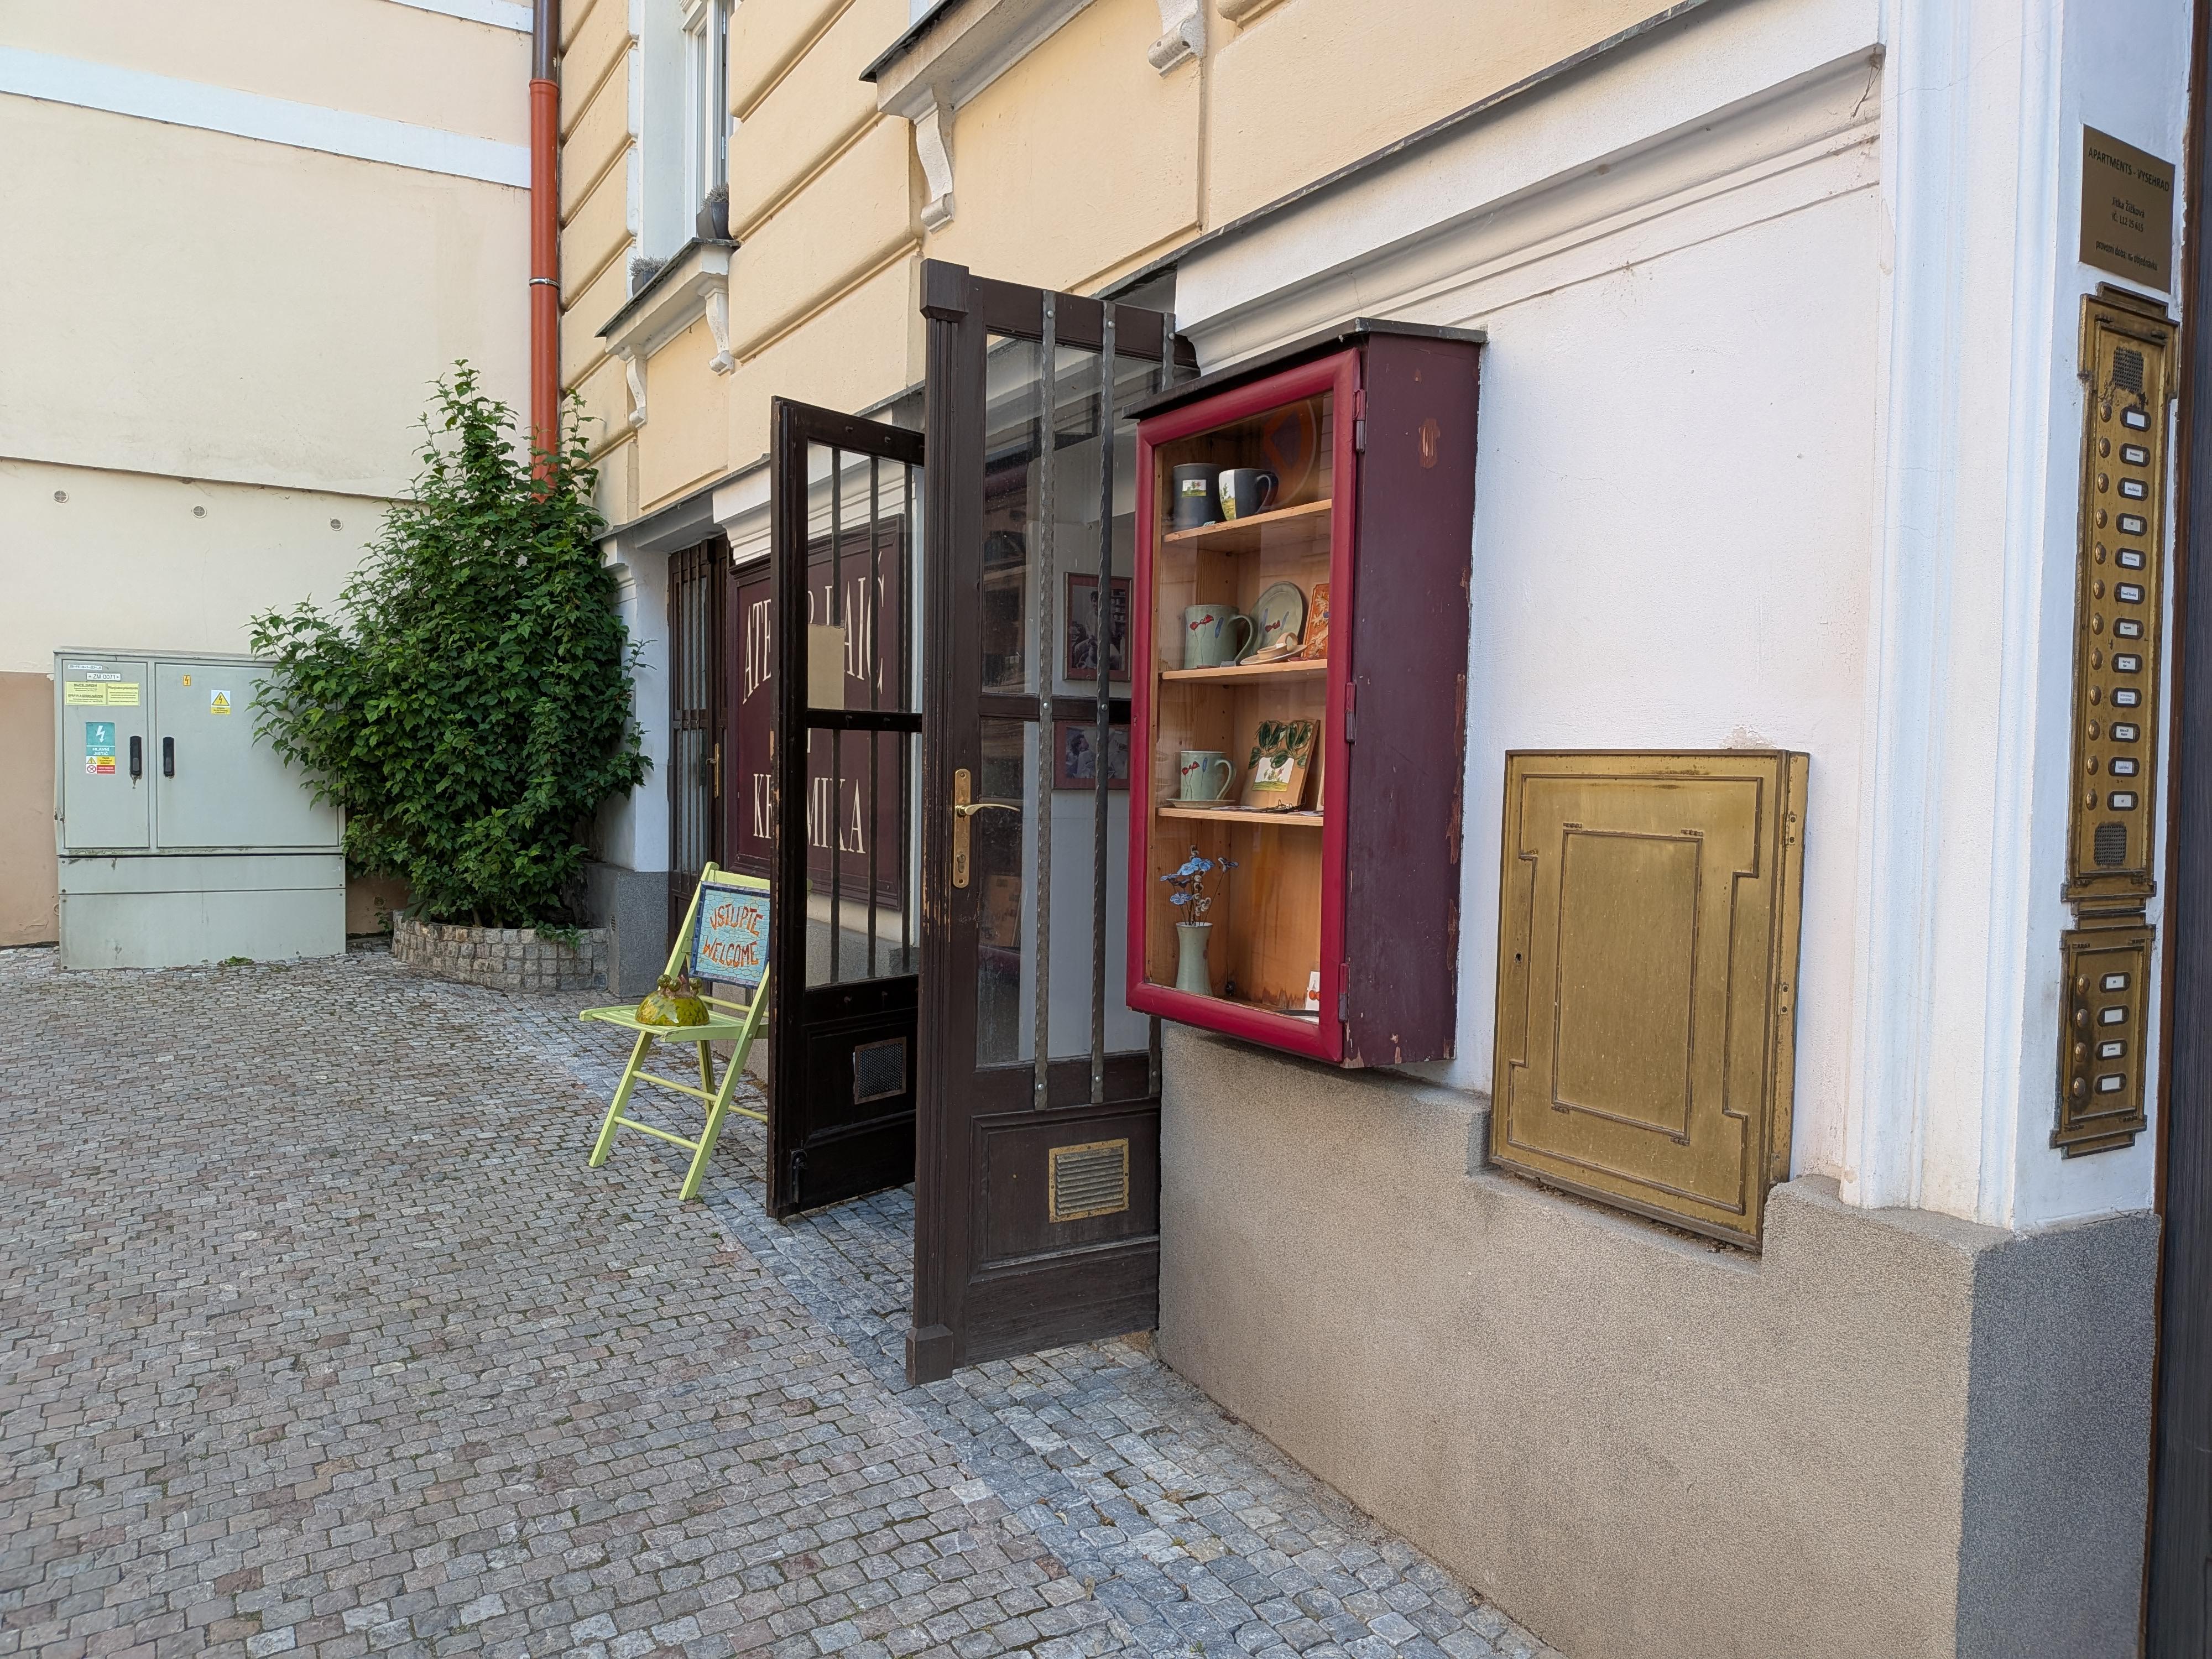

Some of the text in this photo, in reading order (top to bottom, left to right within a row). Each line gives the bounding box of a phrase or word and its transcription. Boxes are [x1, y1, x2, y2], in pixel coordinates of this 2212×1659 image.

[2088, 147, 2132, 175] APARTMENTS
[2112, 197, 2124, 210] Jitka
[709, 903, 764, 937] VSTUPTE
[702, 936, 759, 967] WELCOME
